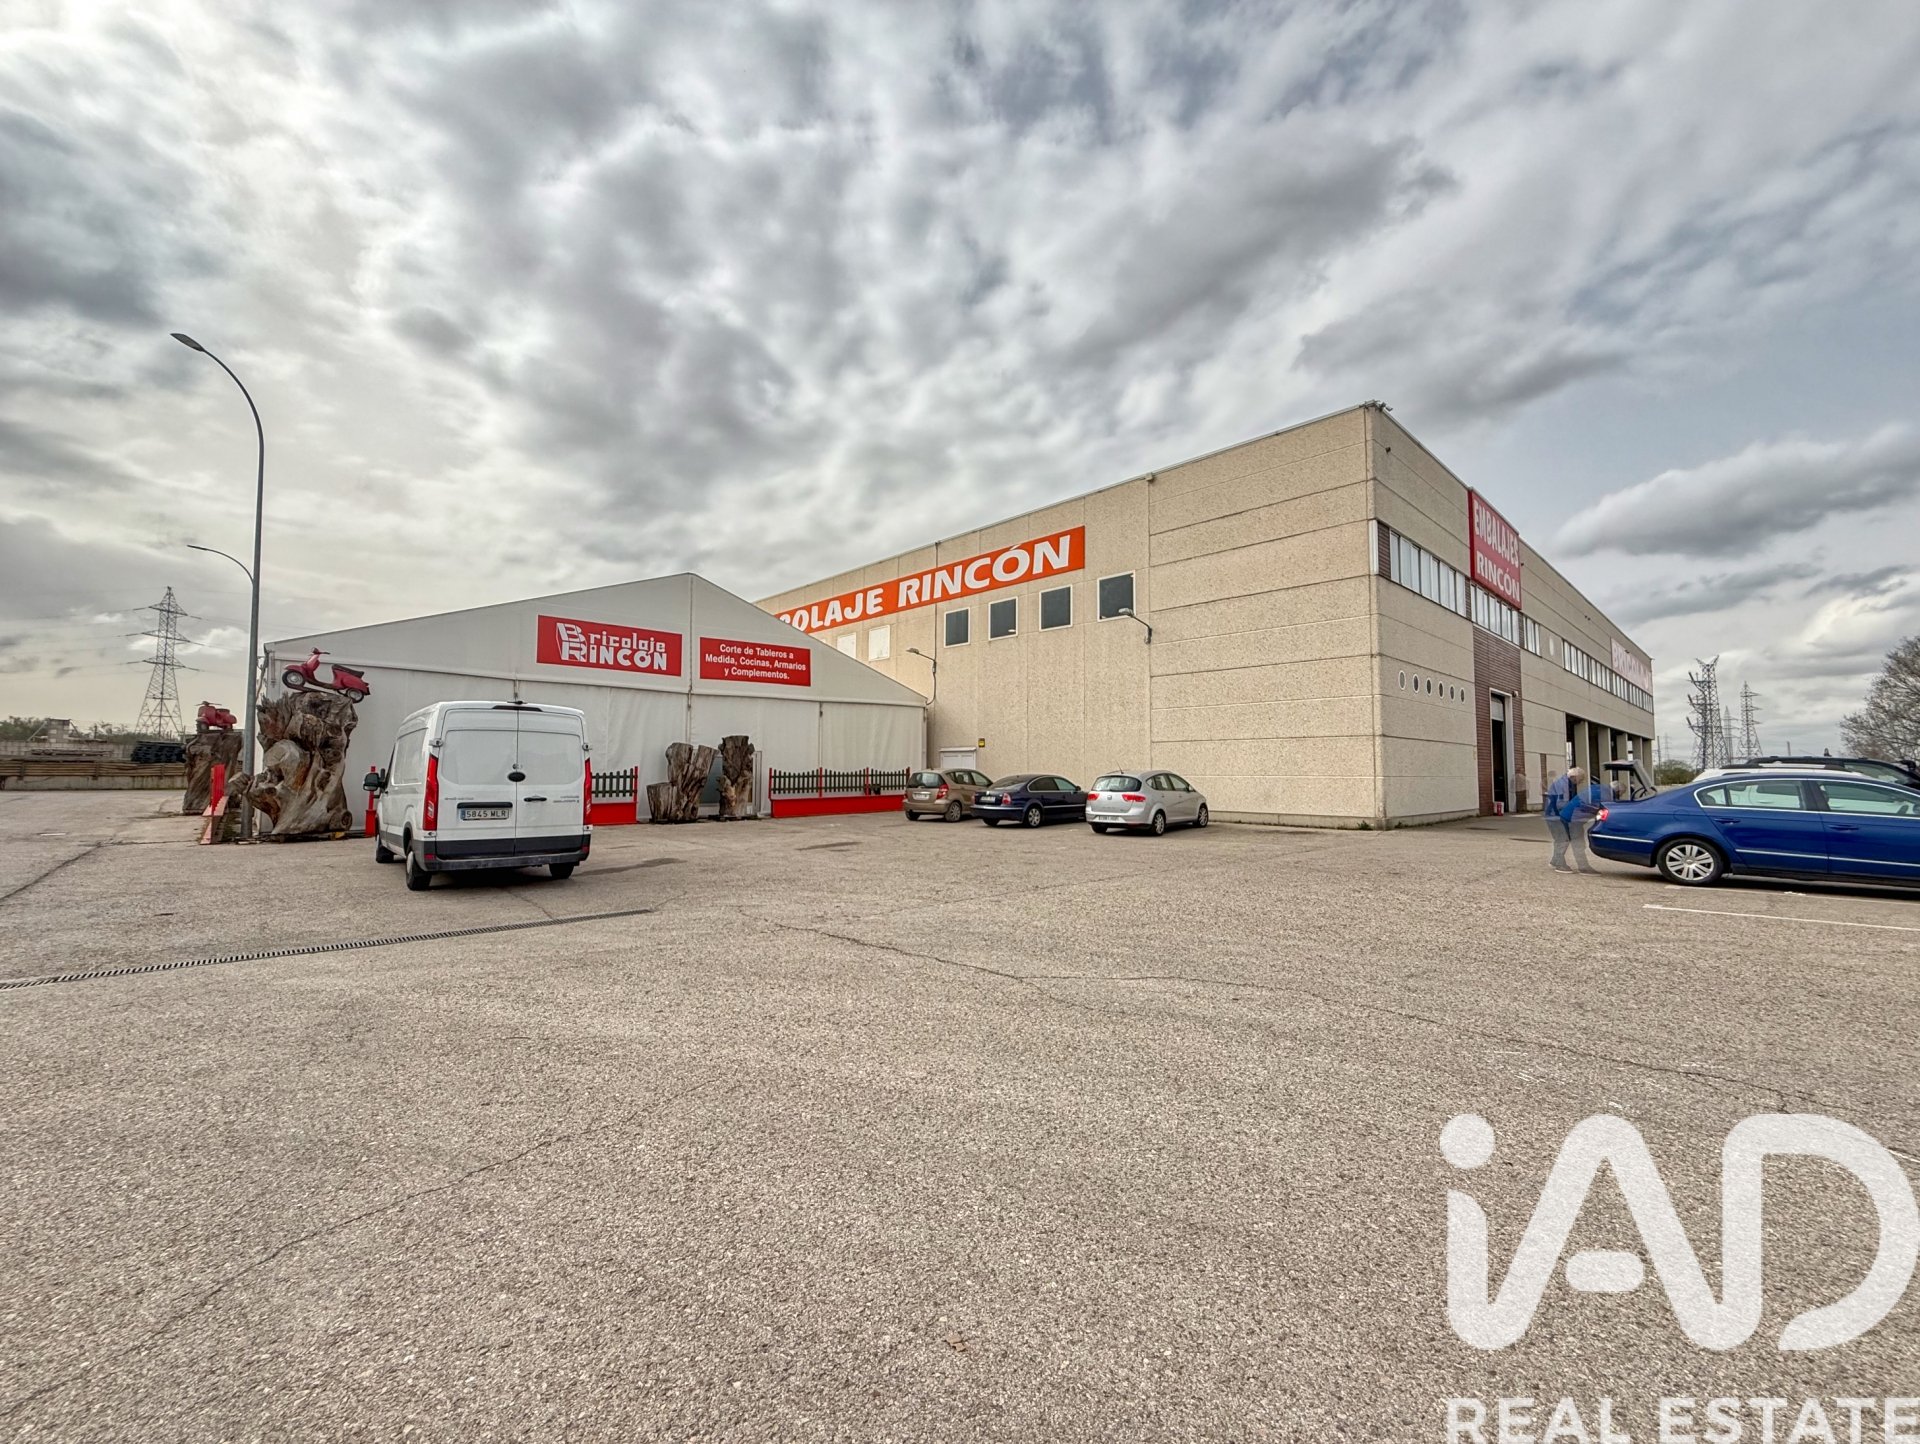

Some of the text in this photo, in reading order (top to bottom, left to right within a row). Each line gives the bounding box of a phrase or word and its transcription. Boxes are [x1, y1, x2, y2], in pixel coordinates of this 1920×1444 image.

[1473, 500, 1519, 568] EMBALAJES
[898, 535, 1071, 607] RINCÓN
[1476, 550, 1520, 602] RINCÓN
[556, 623, 667, 654] Bricolaje
[705, 653, 806, 671] Medida, Cocinas, Armarios
[719, 643, 742, 654] Corte
[744, 646, 754, 655] de
[756, 647, 788, 659] Tableros
[724, 666, 790, 680] y Complementos.
[466, 808, 506, 817] 5845 MLR
